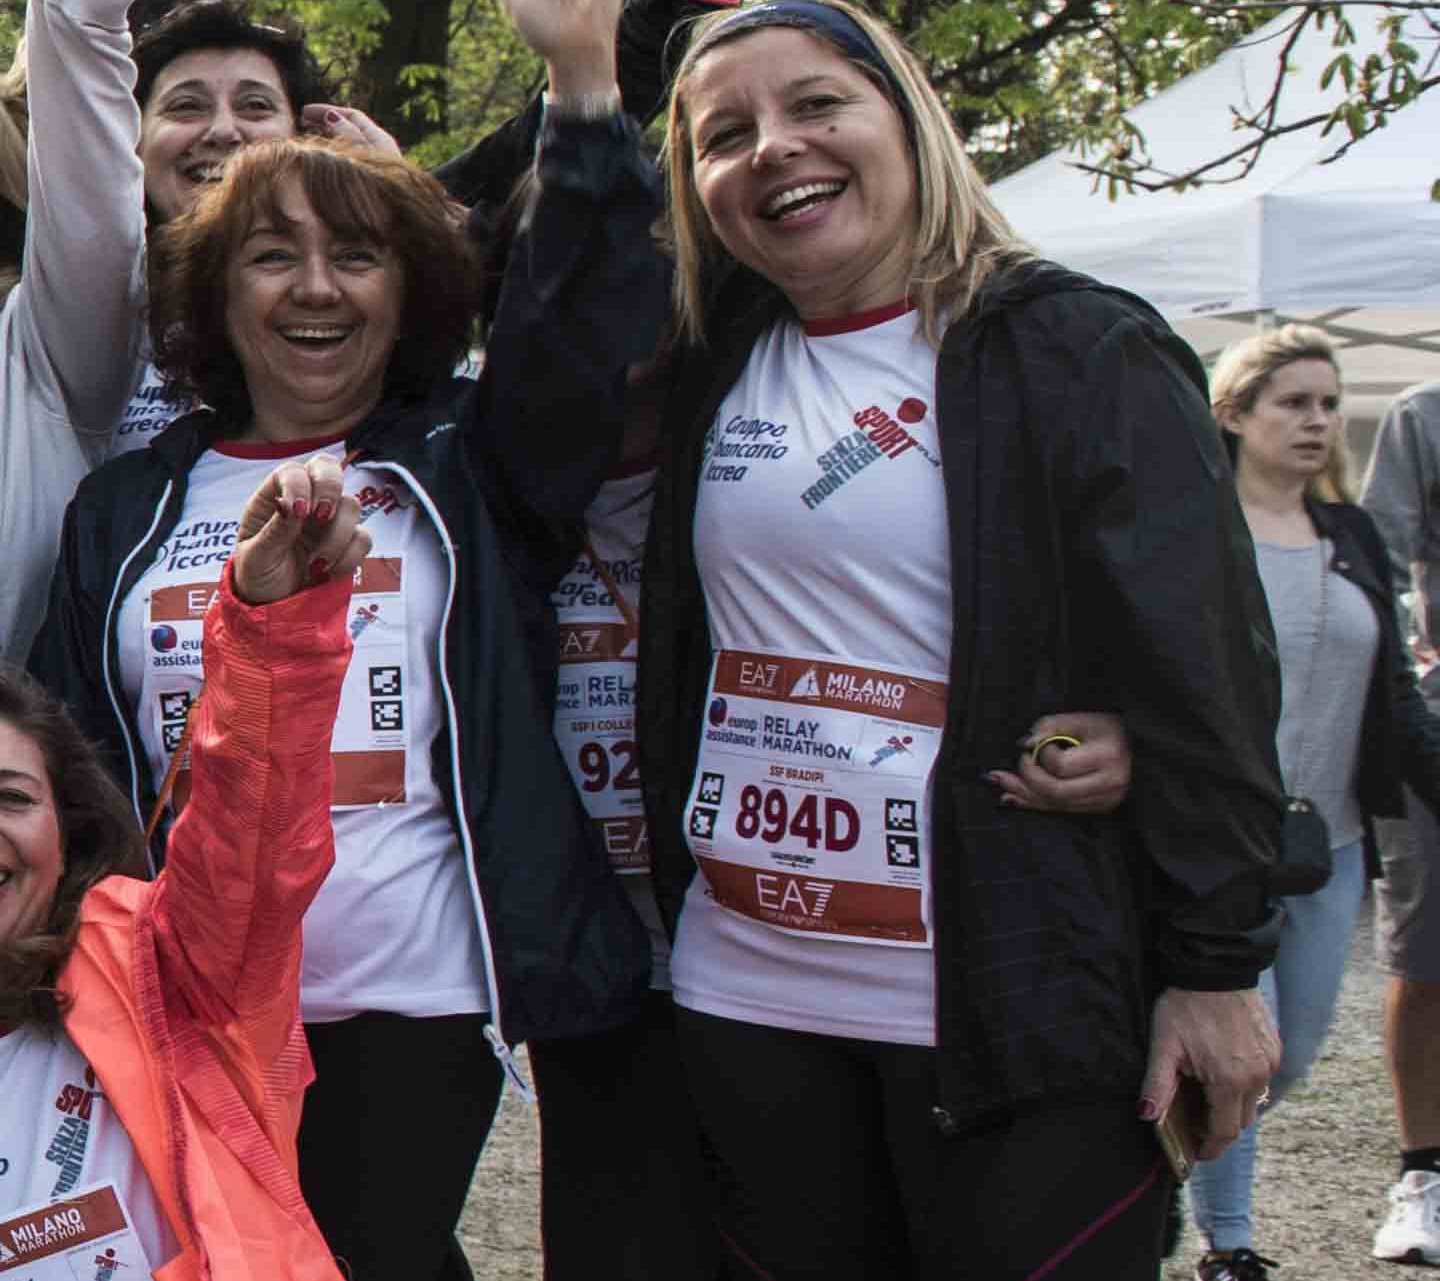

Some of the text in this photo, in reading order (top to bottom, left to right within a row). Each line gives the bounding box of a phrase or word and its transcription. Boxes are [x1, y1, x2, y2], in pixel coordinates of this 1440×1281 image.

[726, 414, 788, 438] Gruppo
[854, 405, 919, 460] SPORT
[817, 431, 868, 472] SENZA
[800, 442, 882, 510] FRONTIERE
[739, 661, 780, 687] EA7
[826, 672, 906, 700] MILANO
[825, 689, 903, 711] MARATHON
[705, 729, 757, 747] assistance
[727, 715, 758, 732] europ
[763, 715, 820, 740] RELAY
[762, 737, 852, 761] MARATHON
[735, 784, 861, 853] 894D
[755, 873, 835, 917] EA7
[45, 1118, 81, 1166] SENZA
[11, 1209, 81, 1244] MILANO
[16, 1222, 86, 1254] MARATHON
